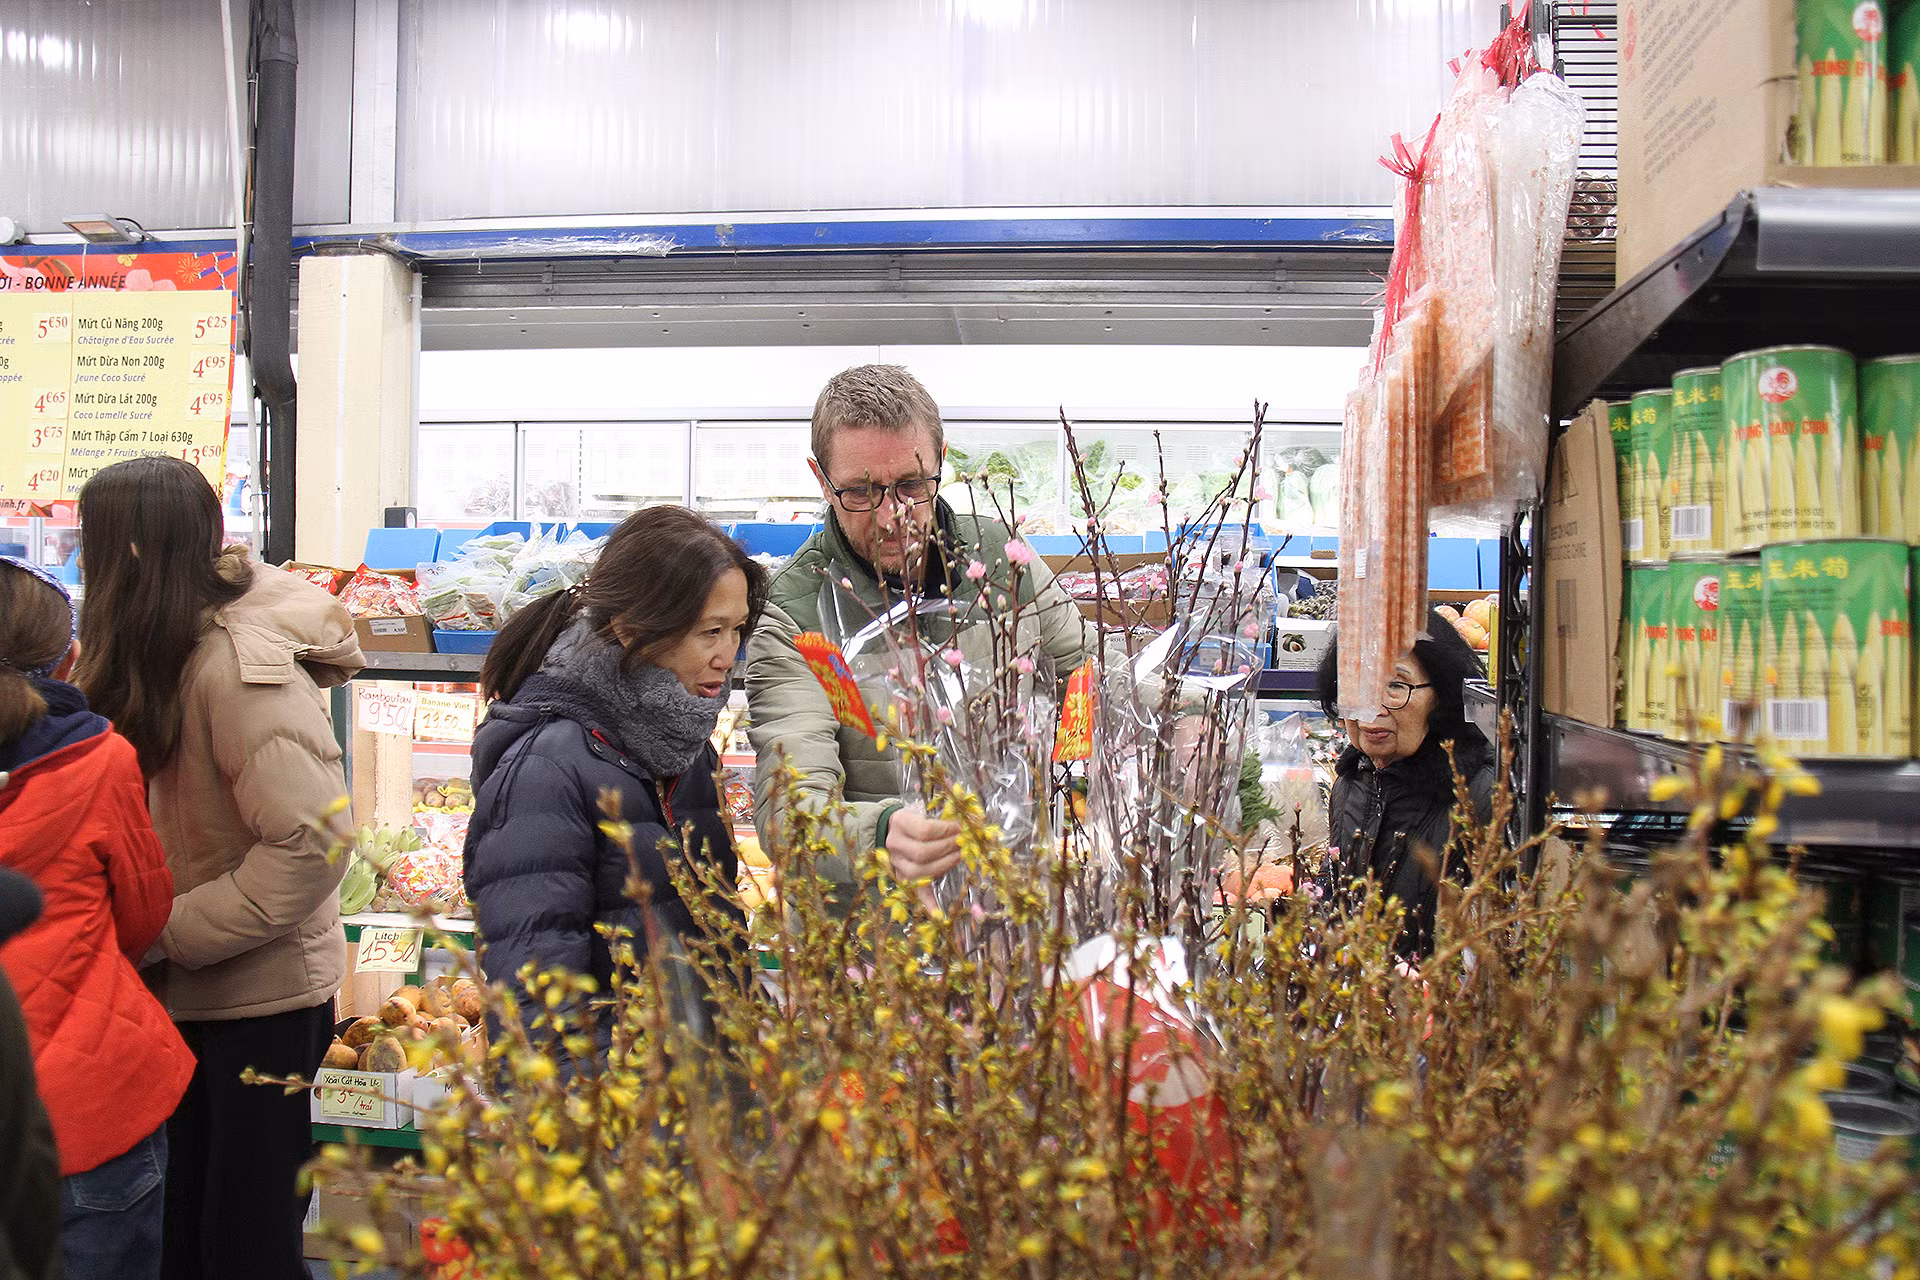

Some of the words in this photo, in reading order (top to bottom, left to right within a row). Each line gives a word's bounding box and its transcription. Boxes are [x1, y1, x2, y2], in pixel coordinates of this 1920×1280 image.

[25, 276, 75, 289] BONNE
[78, 272, 126, 289] ANNÉE
[38, 316, 68, 339] 5€50
[78, 317, 98, 329] Mứt
[101, 316, 112, 329] Củ
[115, 317, 139, 331] Năng
[141, 317, 163, 331] 200g
[195, 316, 227, 339] 5€25
[78, 335, 119, 347] Châtaigne
[121, 335, 144, 345] d'Eau
[146, 335, 174, 345] Sucrée
[77, 355, 97, 367] Mứt
[100, 355, 118, 367] Dừa
[121, 356, 140, 367] Non
[143, 355, 165, 369] 200g
[193, 356, 226, 379] 4€95
[75, 373, 99, 384] Jeune
[101, 373, 121, 383] Coco
[123, 373, 146, 382] Sucré
[35, 391, 66, 413] 4€65
[75, 392, 95, 404] Mứt
[98, 392, 116, 404] Dừa
[119, 393, 133, 404] Lát
[135, 393, 157, 407] 200g
[190, 393, 223, 415] 4€95
[74, 410, 94, 419] Coco
[95, 410, 127, 419] Lamelle
[129, 409, 152, 419] Sucré
[1801, 420, 1829, 435] CORN
[32, 426, 63, 448] 3€75
[72, 429, 92, 441] Mứt
[95, 430, 116, 444] Thập
[141, 431, 147, 441] 7
[150, 430, 168, 444] Loại
[171, 430, 193, 445] 630g
[70, 447, 105, 459] Mélange
[107, 448, 112, 456] 7
[114, 447, 138, 457] Fruits
[28, 469, 59, 491] 4€20
[359, 687, 412, 703] Ramboutan
[421, 697, 451, 708] Banane
